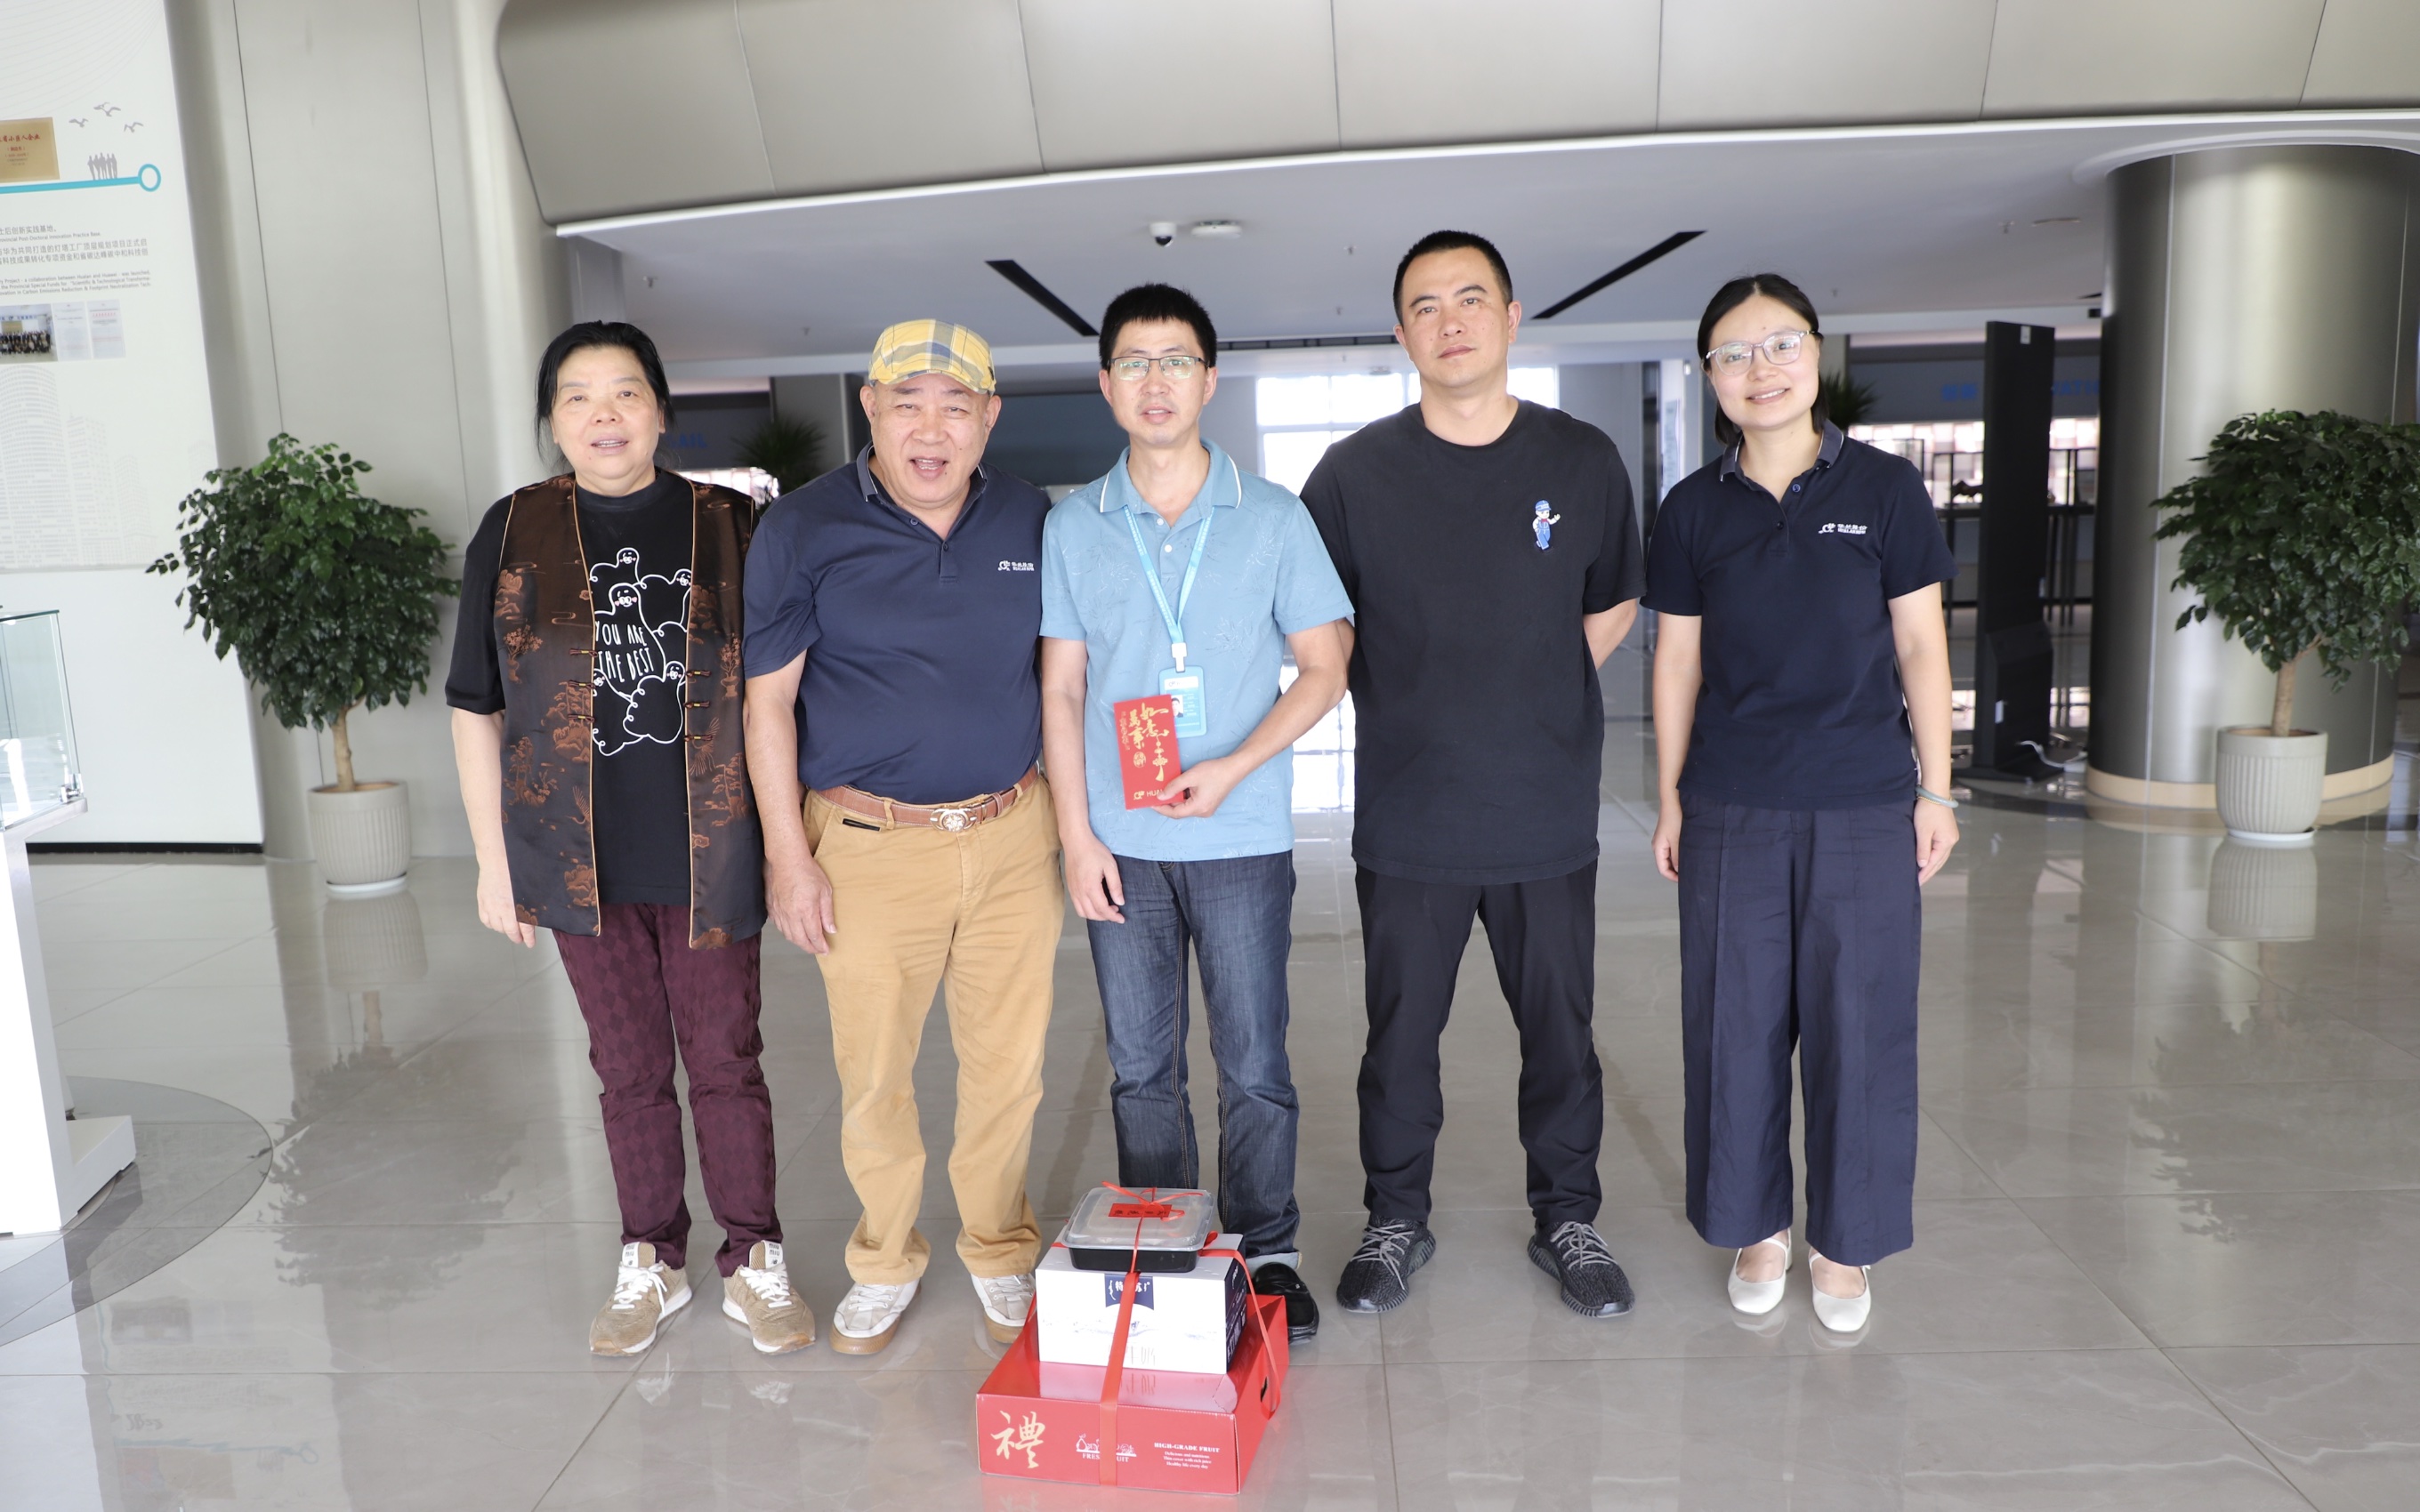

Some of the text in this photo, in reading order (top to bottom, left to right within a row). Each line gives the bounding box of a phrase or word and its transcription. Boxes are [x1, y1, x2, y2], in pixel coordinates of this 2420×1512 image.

[595, 621, 648, 647] YOU ARE
[598, 647, 654, 682] THE BEST
[1115, 1280, 1142, 1292] 特苏
[990, 1410, 1046, 1469] 禮
[1154, 1442, 1221, 1453] HIGH-GRADE FRUIT
[1082, 1452, 1101, 1460] FRES
